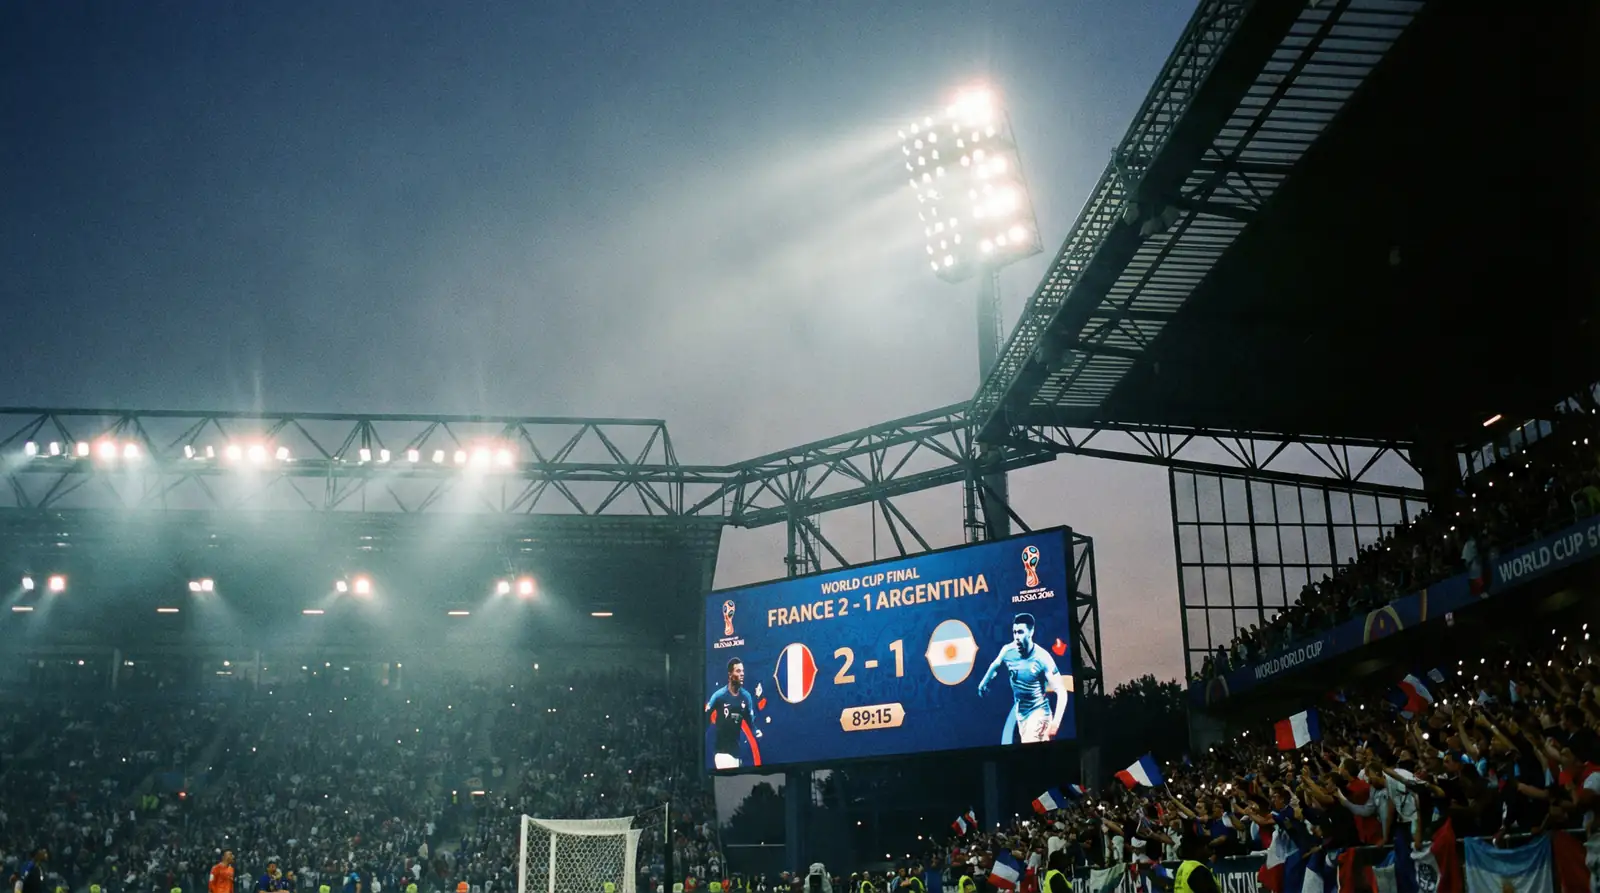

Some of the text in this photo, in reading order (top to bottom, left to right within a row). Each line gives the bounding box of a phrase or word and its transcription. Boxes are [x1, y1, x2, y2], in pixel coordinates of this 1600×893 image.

[1498, 546, 1550, 583] WORLD
[1552, 532, 1583, 560] CUP
[768, 600, 834, 627] FRANCE
[838, 597, 848, 616] 2
[864, 593, 871, 612] 1
[876, 574, 989, 610] ARGENTINA
[821, 567, 919, 595] WORLD CUP FINAL
[834, 647, 855, 684] 2
[889, 639, 904, 678] 1
[1254, 659, 1279, 679] WORLD
[1306, 641, 1322, 659] CUP
[852, 708, 892, 726] 89:15
